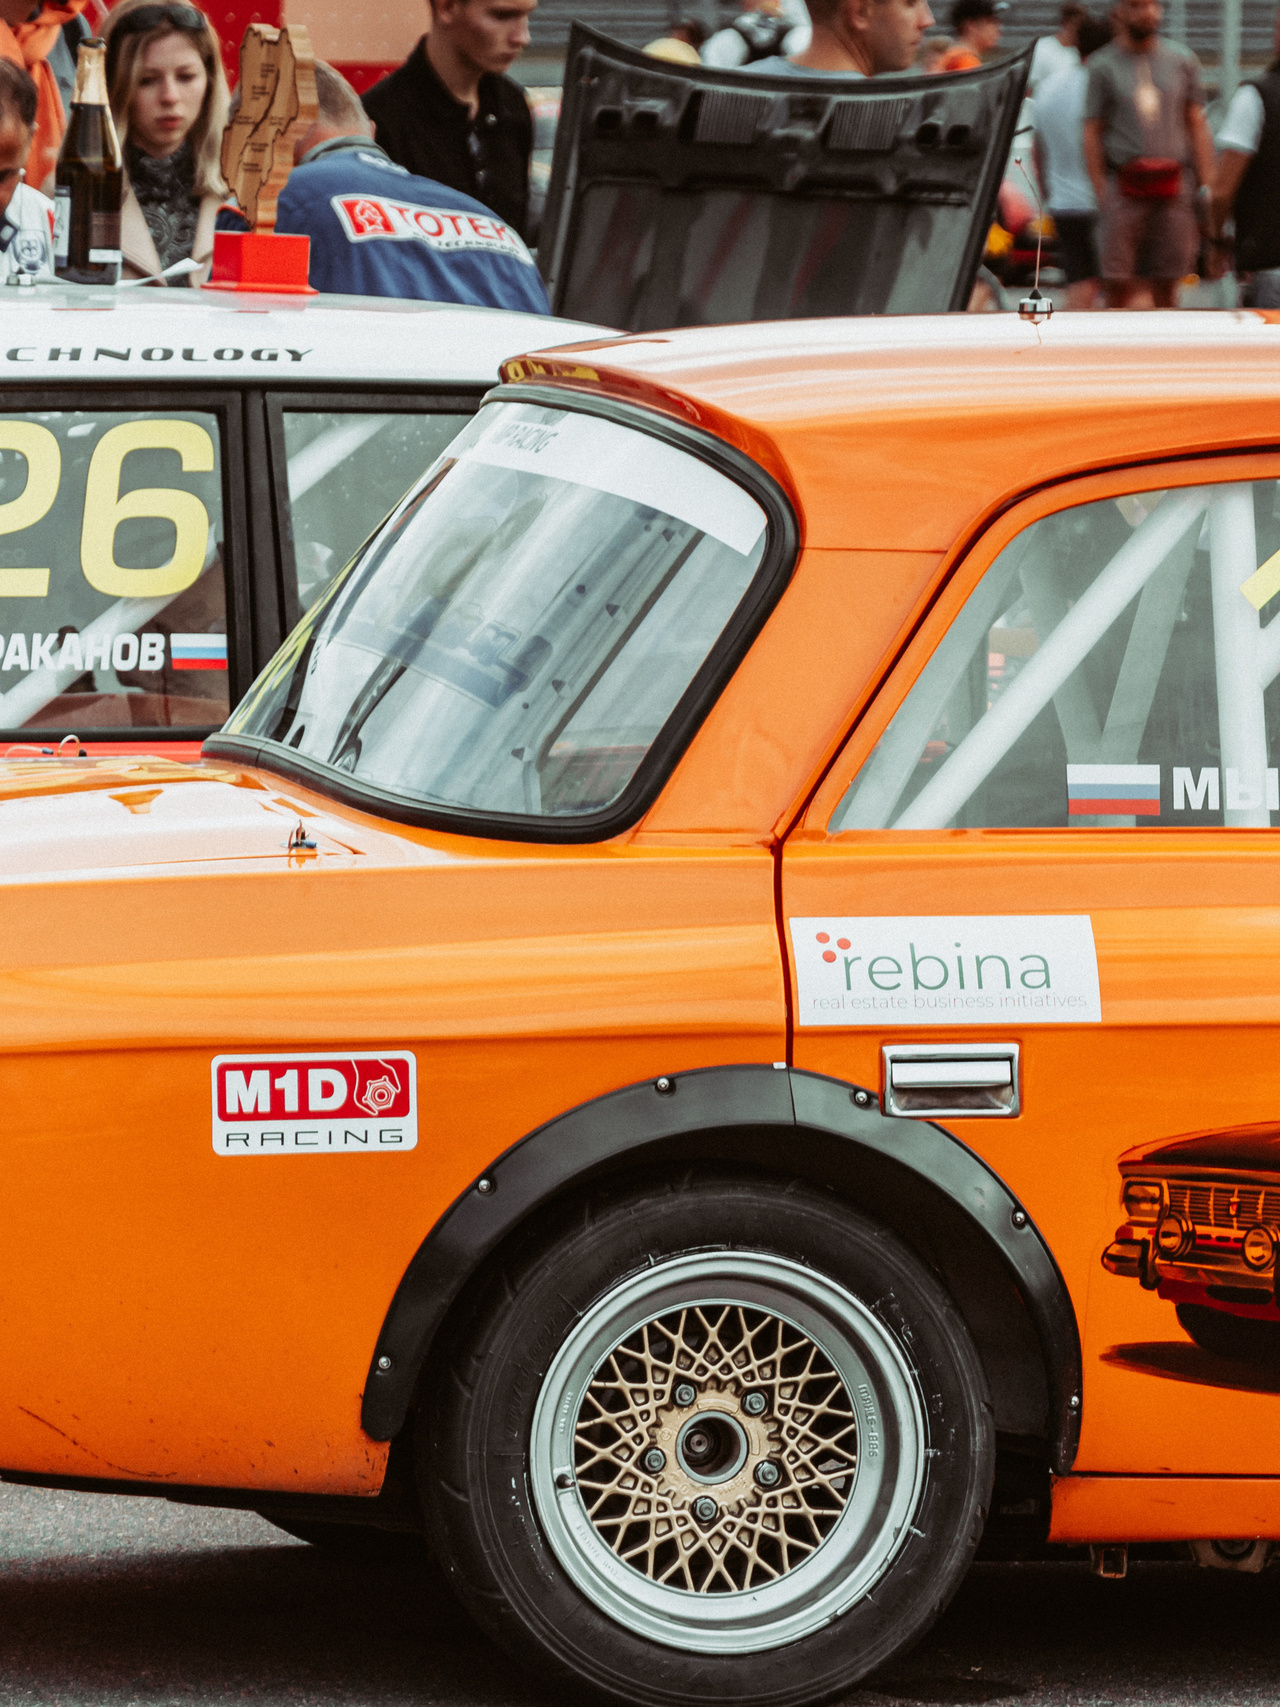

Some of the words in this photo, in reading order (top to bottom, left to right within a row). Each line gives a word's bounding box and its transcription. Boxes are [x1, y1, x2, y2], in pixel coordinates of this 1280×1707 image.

[0, 632, 166, 672] АКАНОВ
[843, 942, 1052, 991] rebina
[812, 993, 846, 1010] real
[850, 993, 908, 1010] estate
[913, 992, 995, 1009] business
[999, 991, 1088, 1009] initiatives
[225, 1068, 348, 1115] M1D
[226, 1128, 403, 1148] RACING
